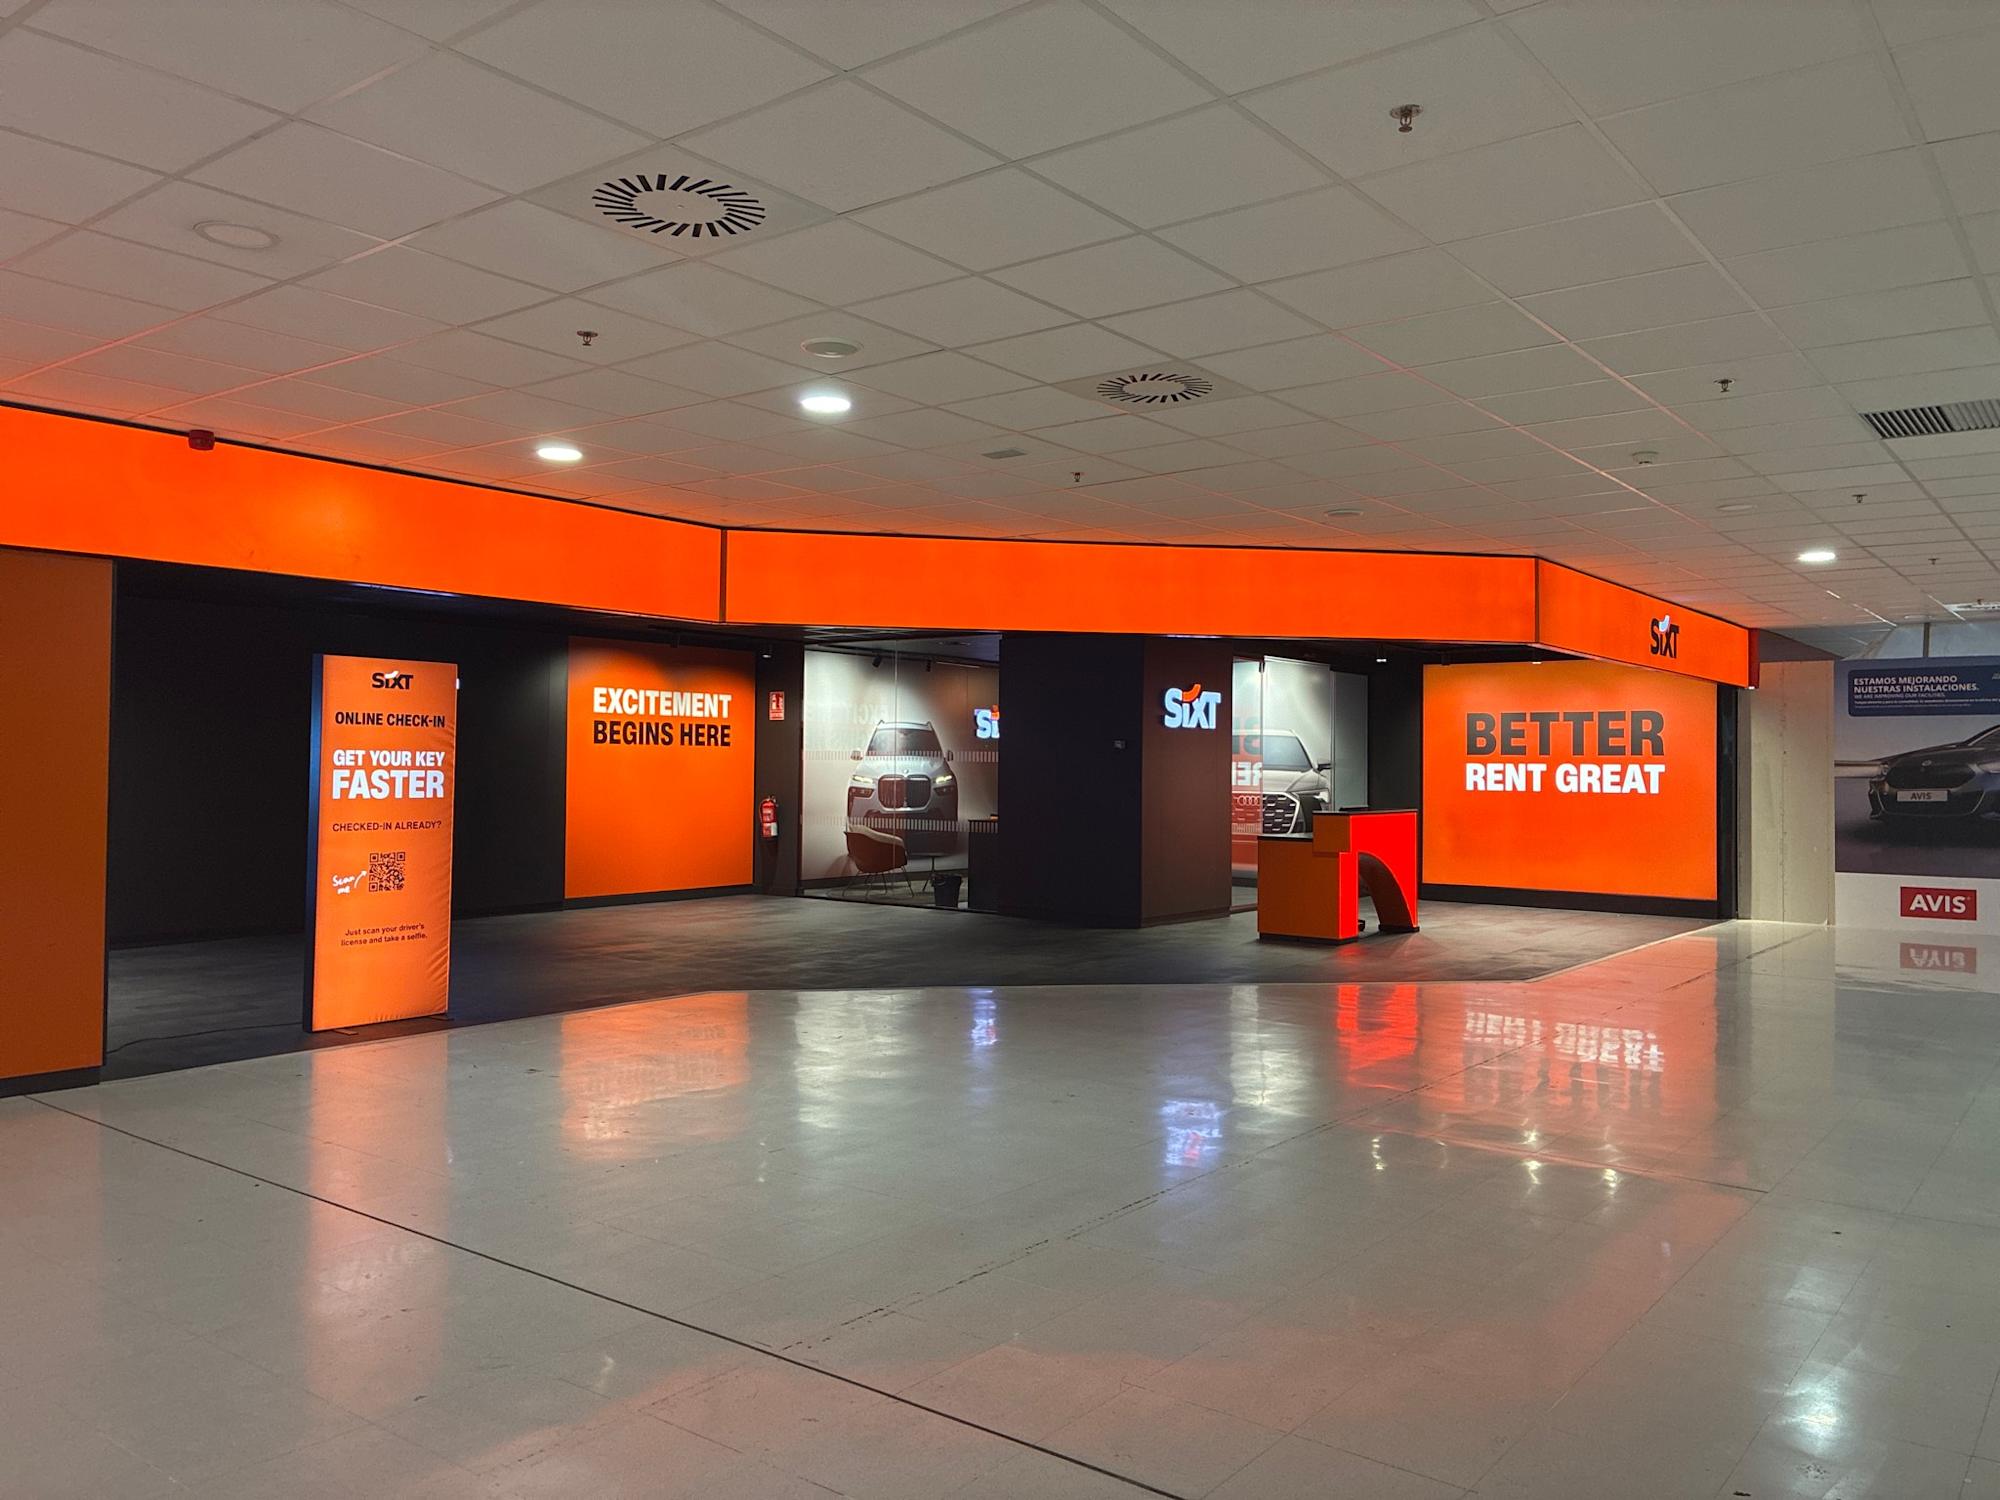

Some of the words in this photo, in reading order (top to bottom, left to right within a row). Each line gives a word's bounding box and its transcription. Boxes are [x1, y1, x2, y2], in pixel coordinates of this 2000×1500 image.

[1854, 677, 1896, 686] ESTAMOS
[1898, 675, 1958, 685] MEJORANDO
[1854, 684, 1901, 694] NUESTRAS
[1903, 683, 1980, 692] INSTALACIONES.
[593, 687, 732, 718] EXCITEMENT
[335, 711, 383, 725] ONLINE
[387, 713, 445, 728] CHECK-IN
[975, 704, 1000, 739] SI
[593, 720, 673, 746] BEGINS
[680, 723, 731, 747] HERE
[1466, 710, 1665, 756] BETTER
[333, 749, 366, 767] GET
[370, 750, 412, 767] YOUR
[415, 751, 446, 767] KEY
[332, 769, 445, 800] FASTER
[1465, 762, 1547, 792] RENT
[1555, 763, 1666, 794] GREAT
[1910, 792, 1932, 800] AVIS
[332, 822, 392, 832] CHECKED-IN
[394, 820, 442, 830] ALREADY?
[1909, 894, 1966, 913] AVIS
[381, 926, 397, 935] your
[399, 922, 425, 931] driver's
[341, 938, 368, 946] license
[369, 936, 383, 944] and
